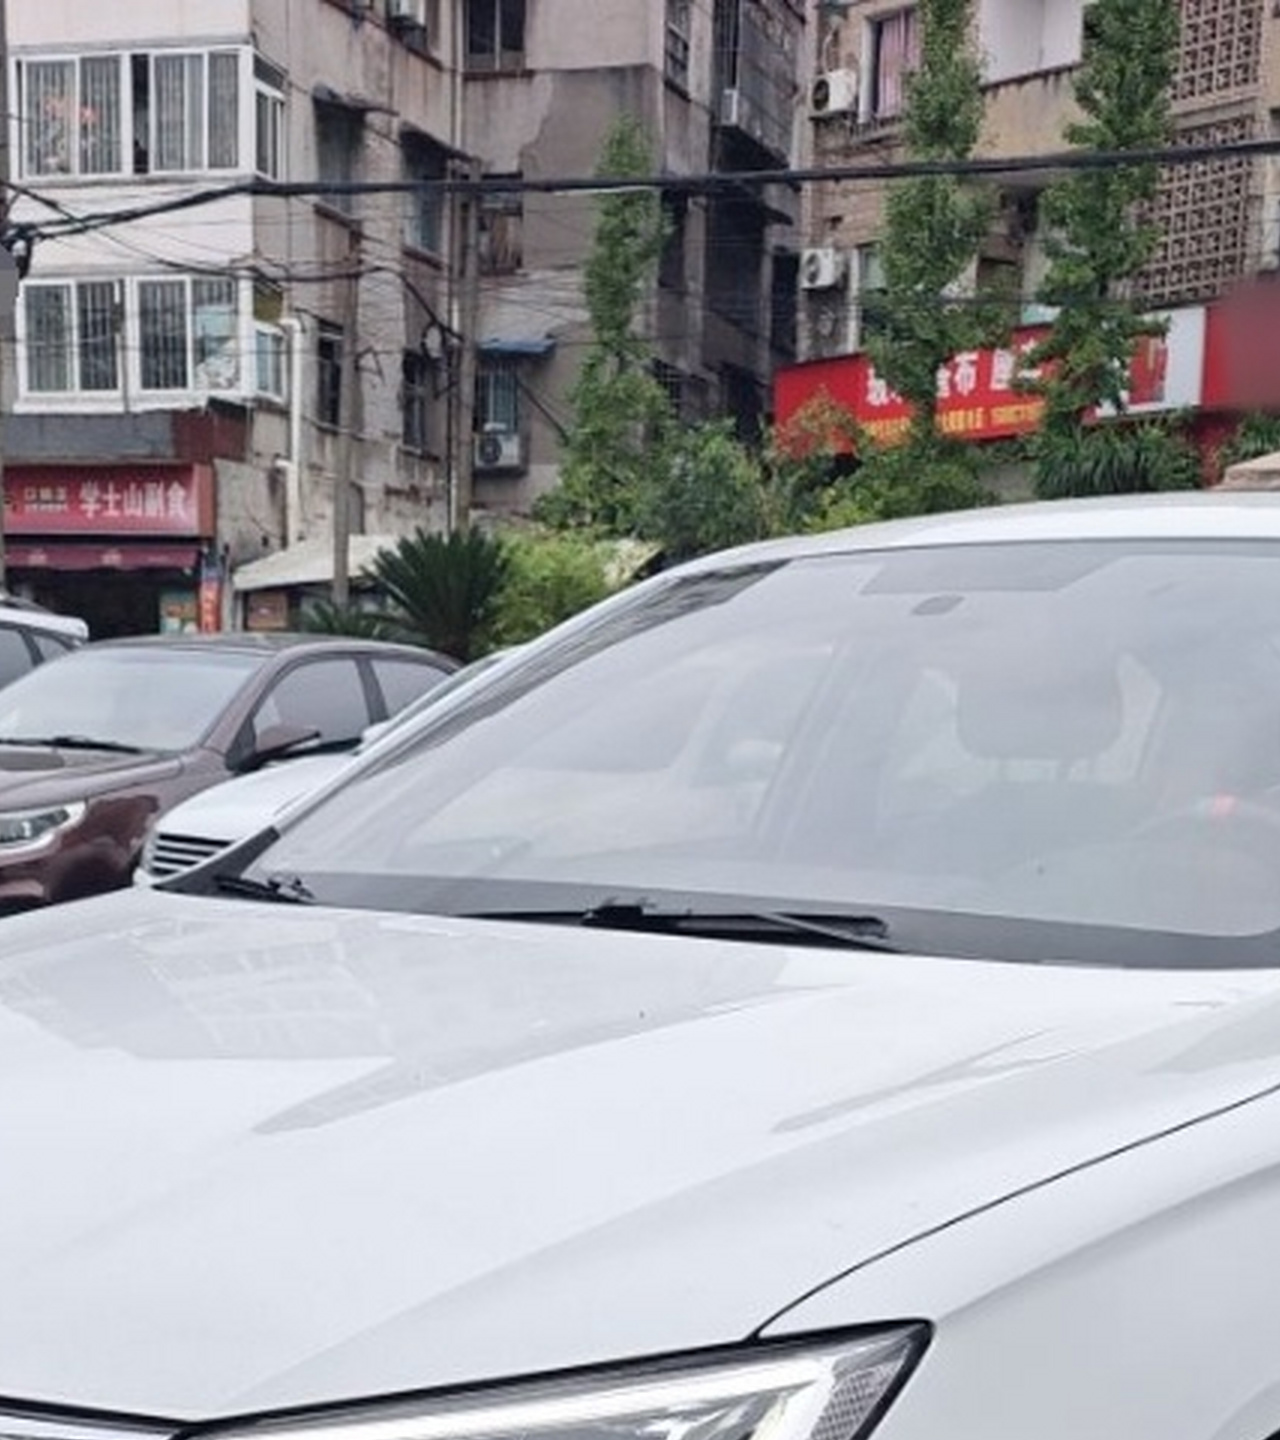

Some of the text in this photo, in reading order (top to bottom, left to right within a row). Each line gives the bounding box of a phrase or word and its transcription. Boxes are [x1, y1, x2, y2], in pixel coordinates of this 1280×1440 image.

[80, 480, 187, 518] 学士山副食
